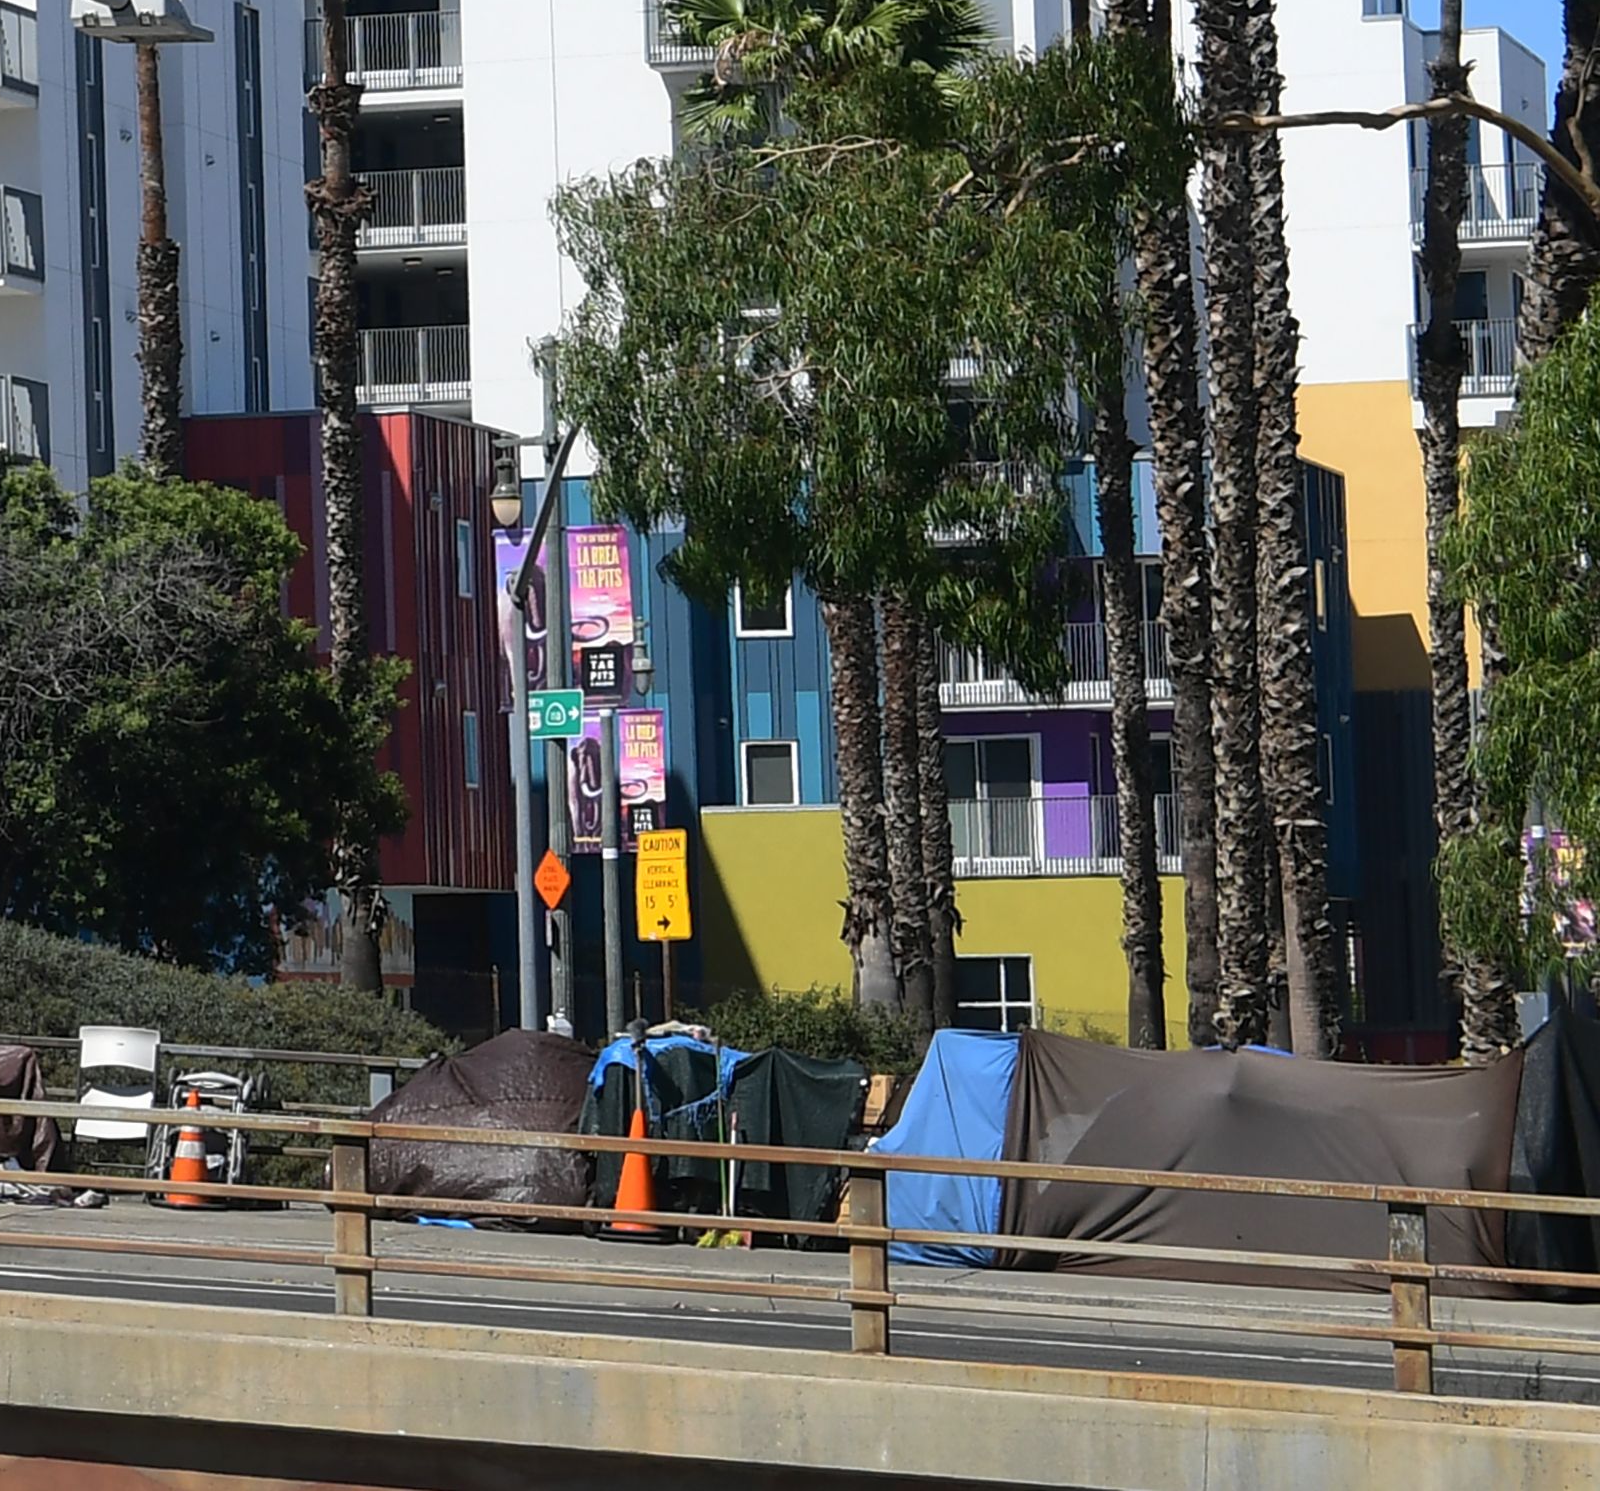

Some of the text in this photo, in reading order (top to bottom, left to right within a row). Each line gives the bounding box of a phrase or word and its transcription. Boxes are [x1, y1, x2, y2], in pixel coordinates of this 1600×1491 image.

[577, 545, 620, 566] LA BREA
[576, 568, 623, 588] TAR PITS
[590, 660, 614, 670] TAR
[590, 670, 615, 681] PITS
[634, 813, 652, 823] TAR
[642, 836, 681, 852] CAUTION
